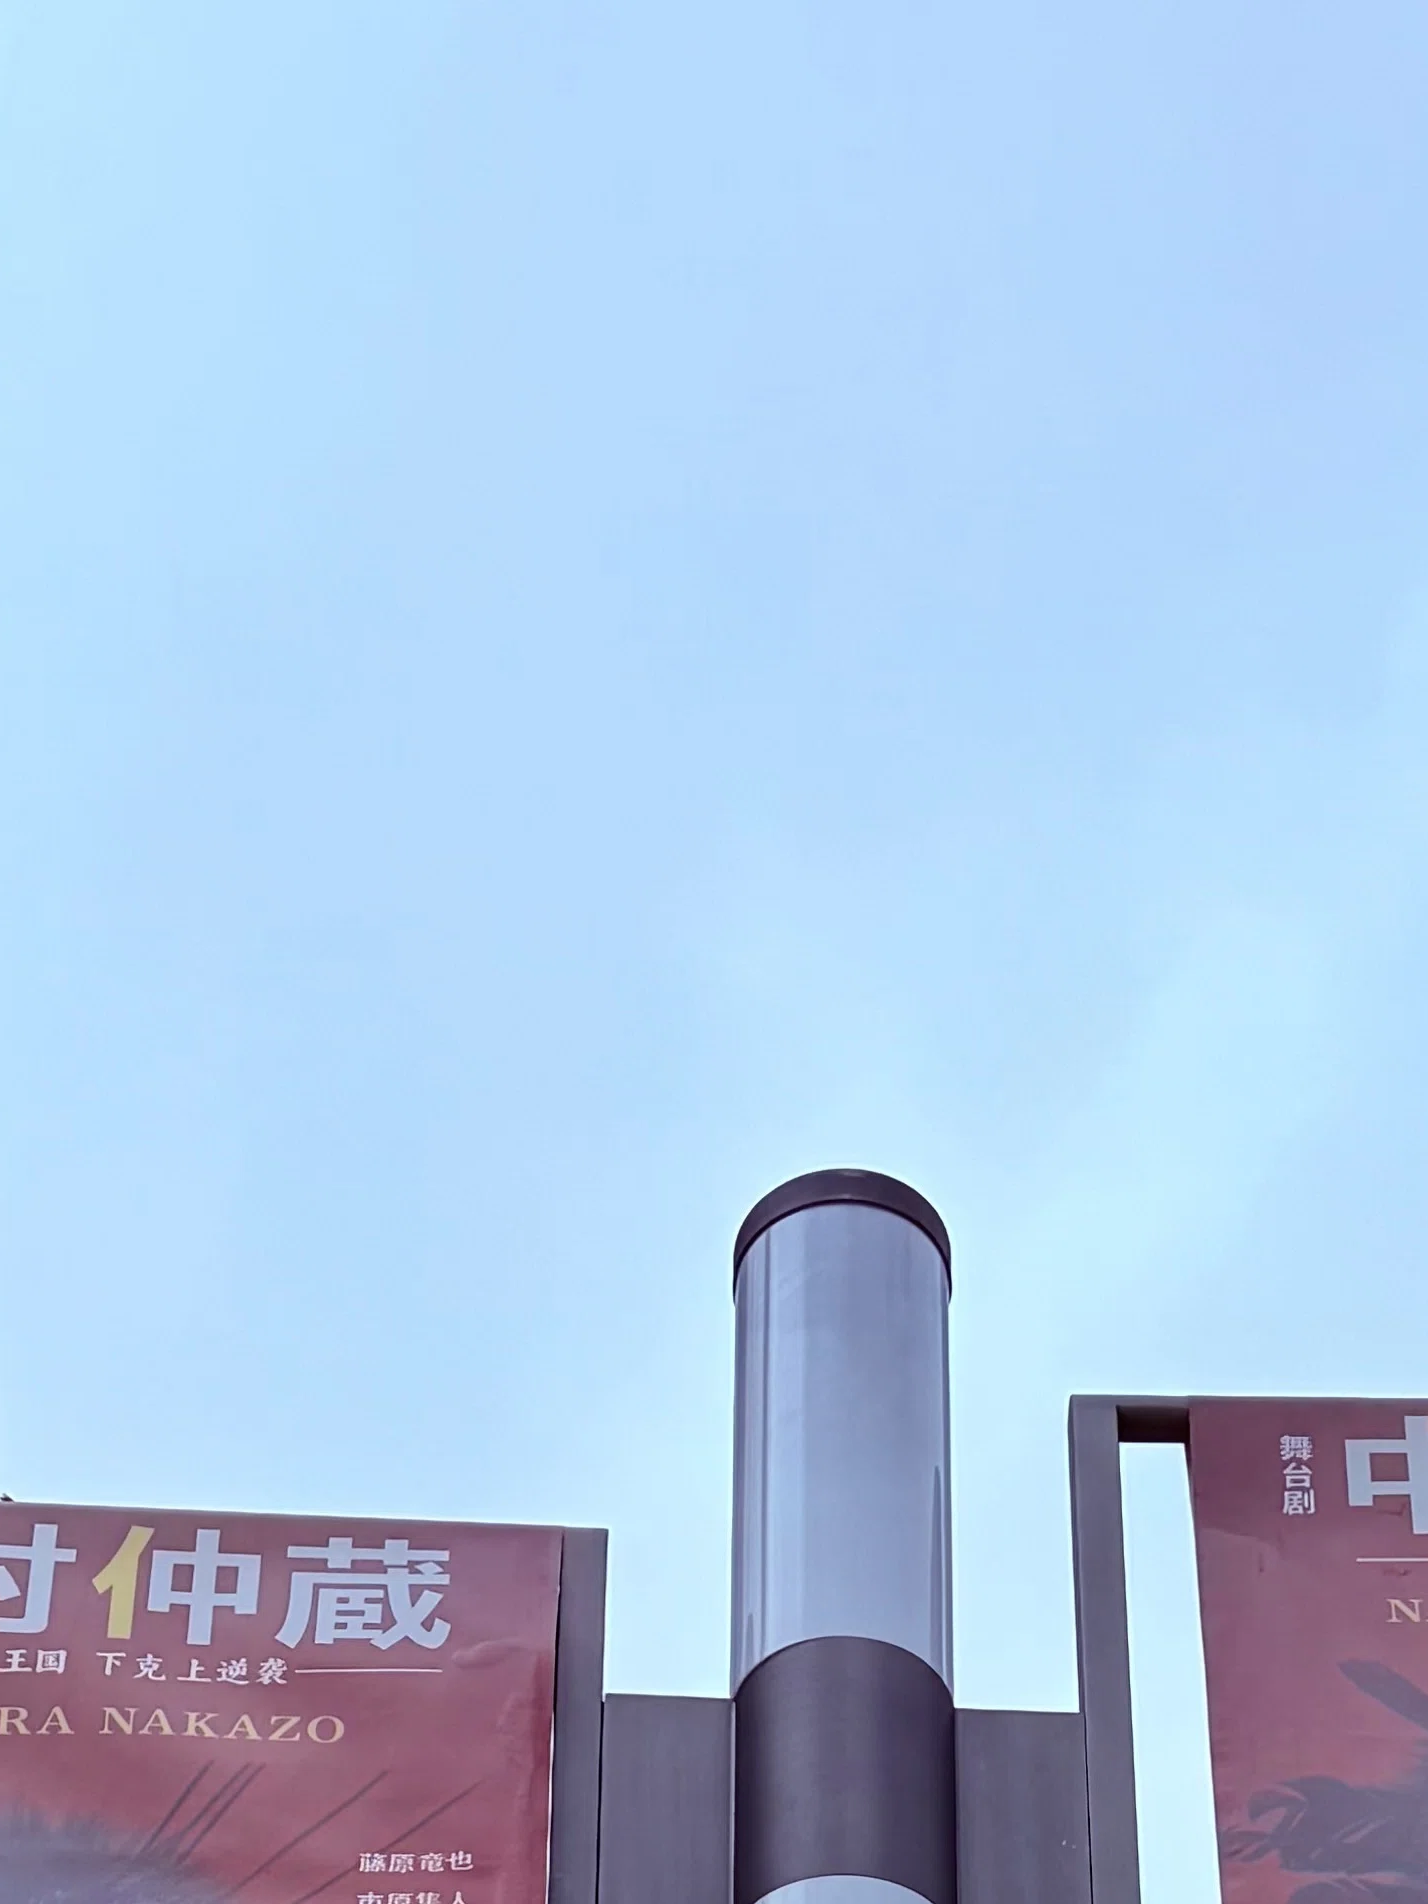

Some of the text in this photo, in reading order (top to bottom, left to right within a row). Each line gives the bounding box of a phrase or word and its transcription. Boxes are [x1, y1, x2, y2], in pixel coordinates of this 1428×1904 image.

[1280, 1435, 1315, 1517] 舞台剧
[96, 1651, 288, 1686] 下克上逆袭
[99, 1706, 346, 1744] NAKAZO
